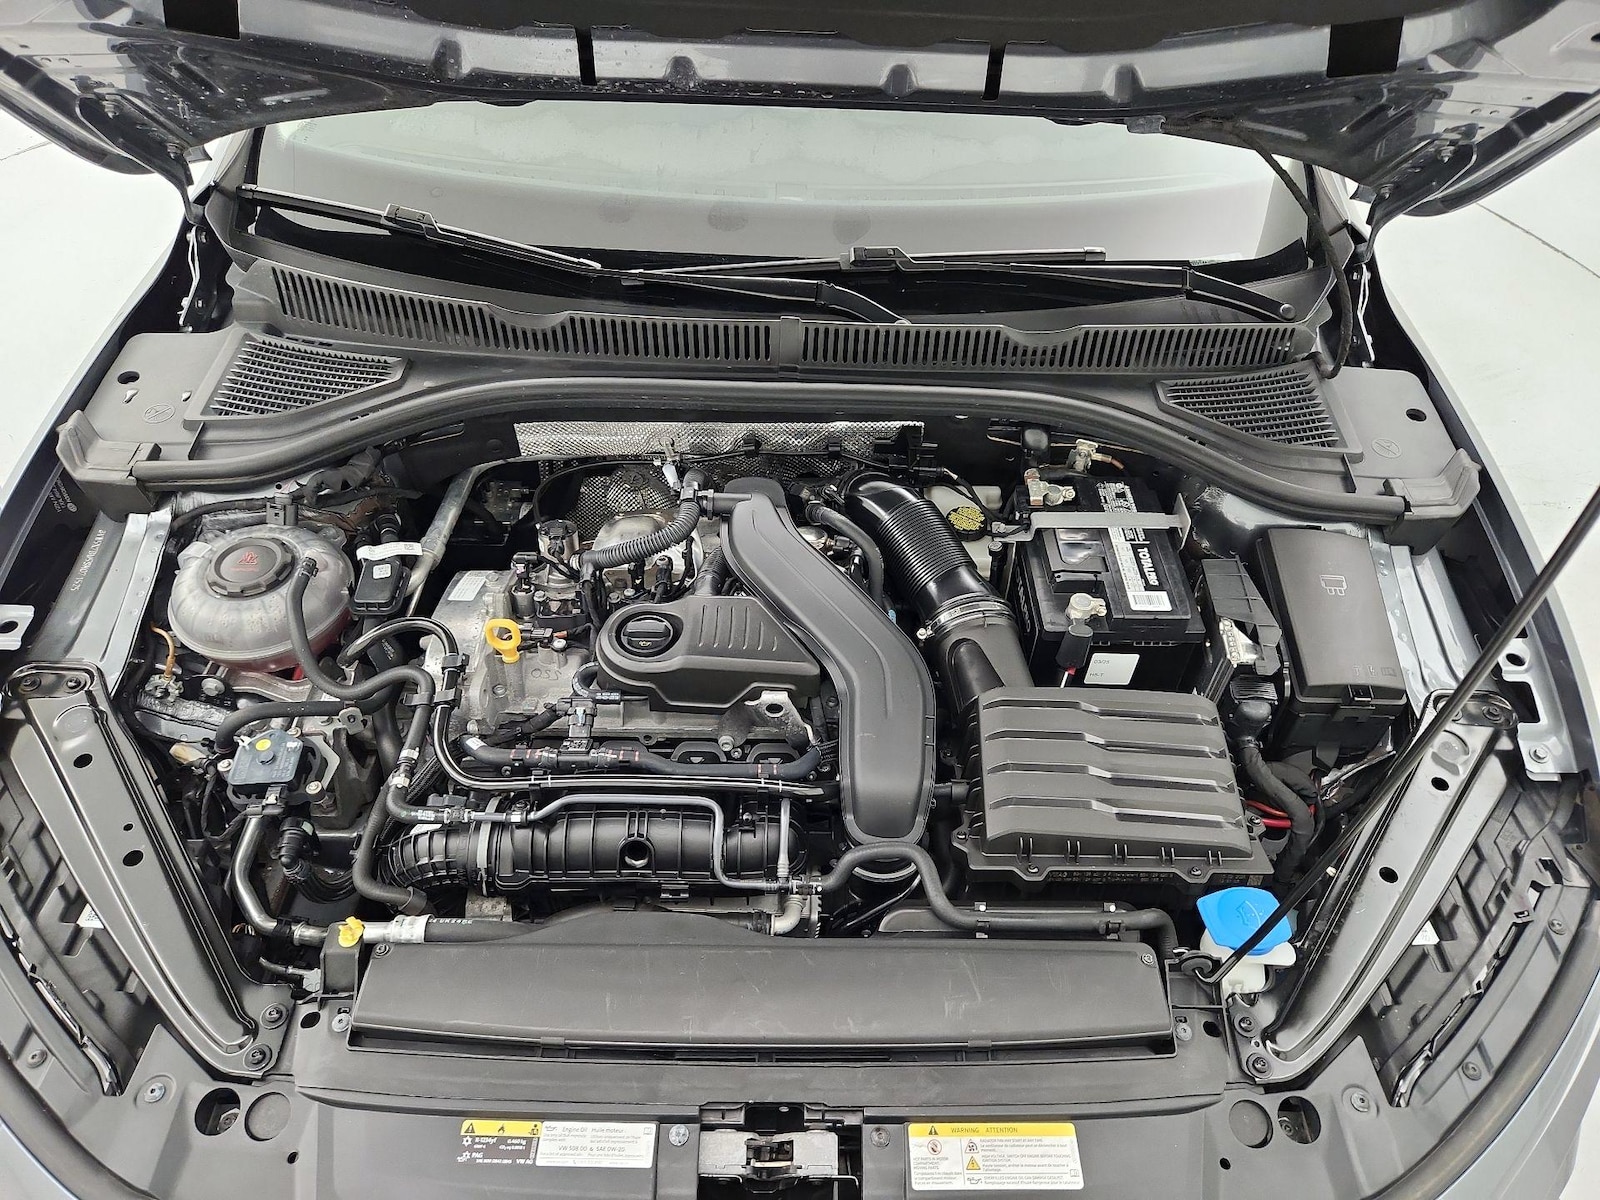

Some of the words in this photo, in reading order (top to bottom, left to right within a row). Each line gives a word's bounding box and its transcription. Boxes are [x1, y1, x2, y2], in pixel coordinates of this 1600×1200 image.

[1137, 547, 1159, 586] TOTALPRO
[562, 1126, 580, 1134] Engine
[950, 1126, 980, 1134] WARNING
[985, 1126, 1018, 1134] ATTENTION
[471, 1151, 484, 1159] PAG
